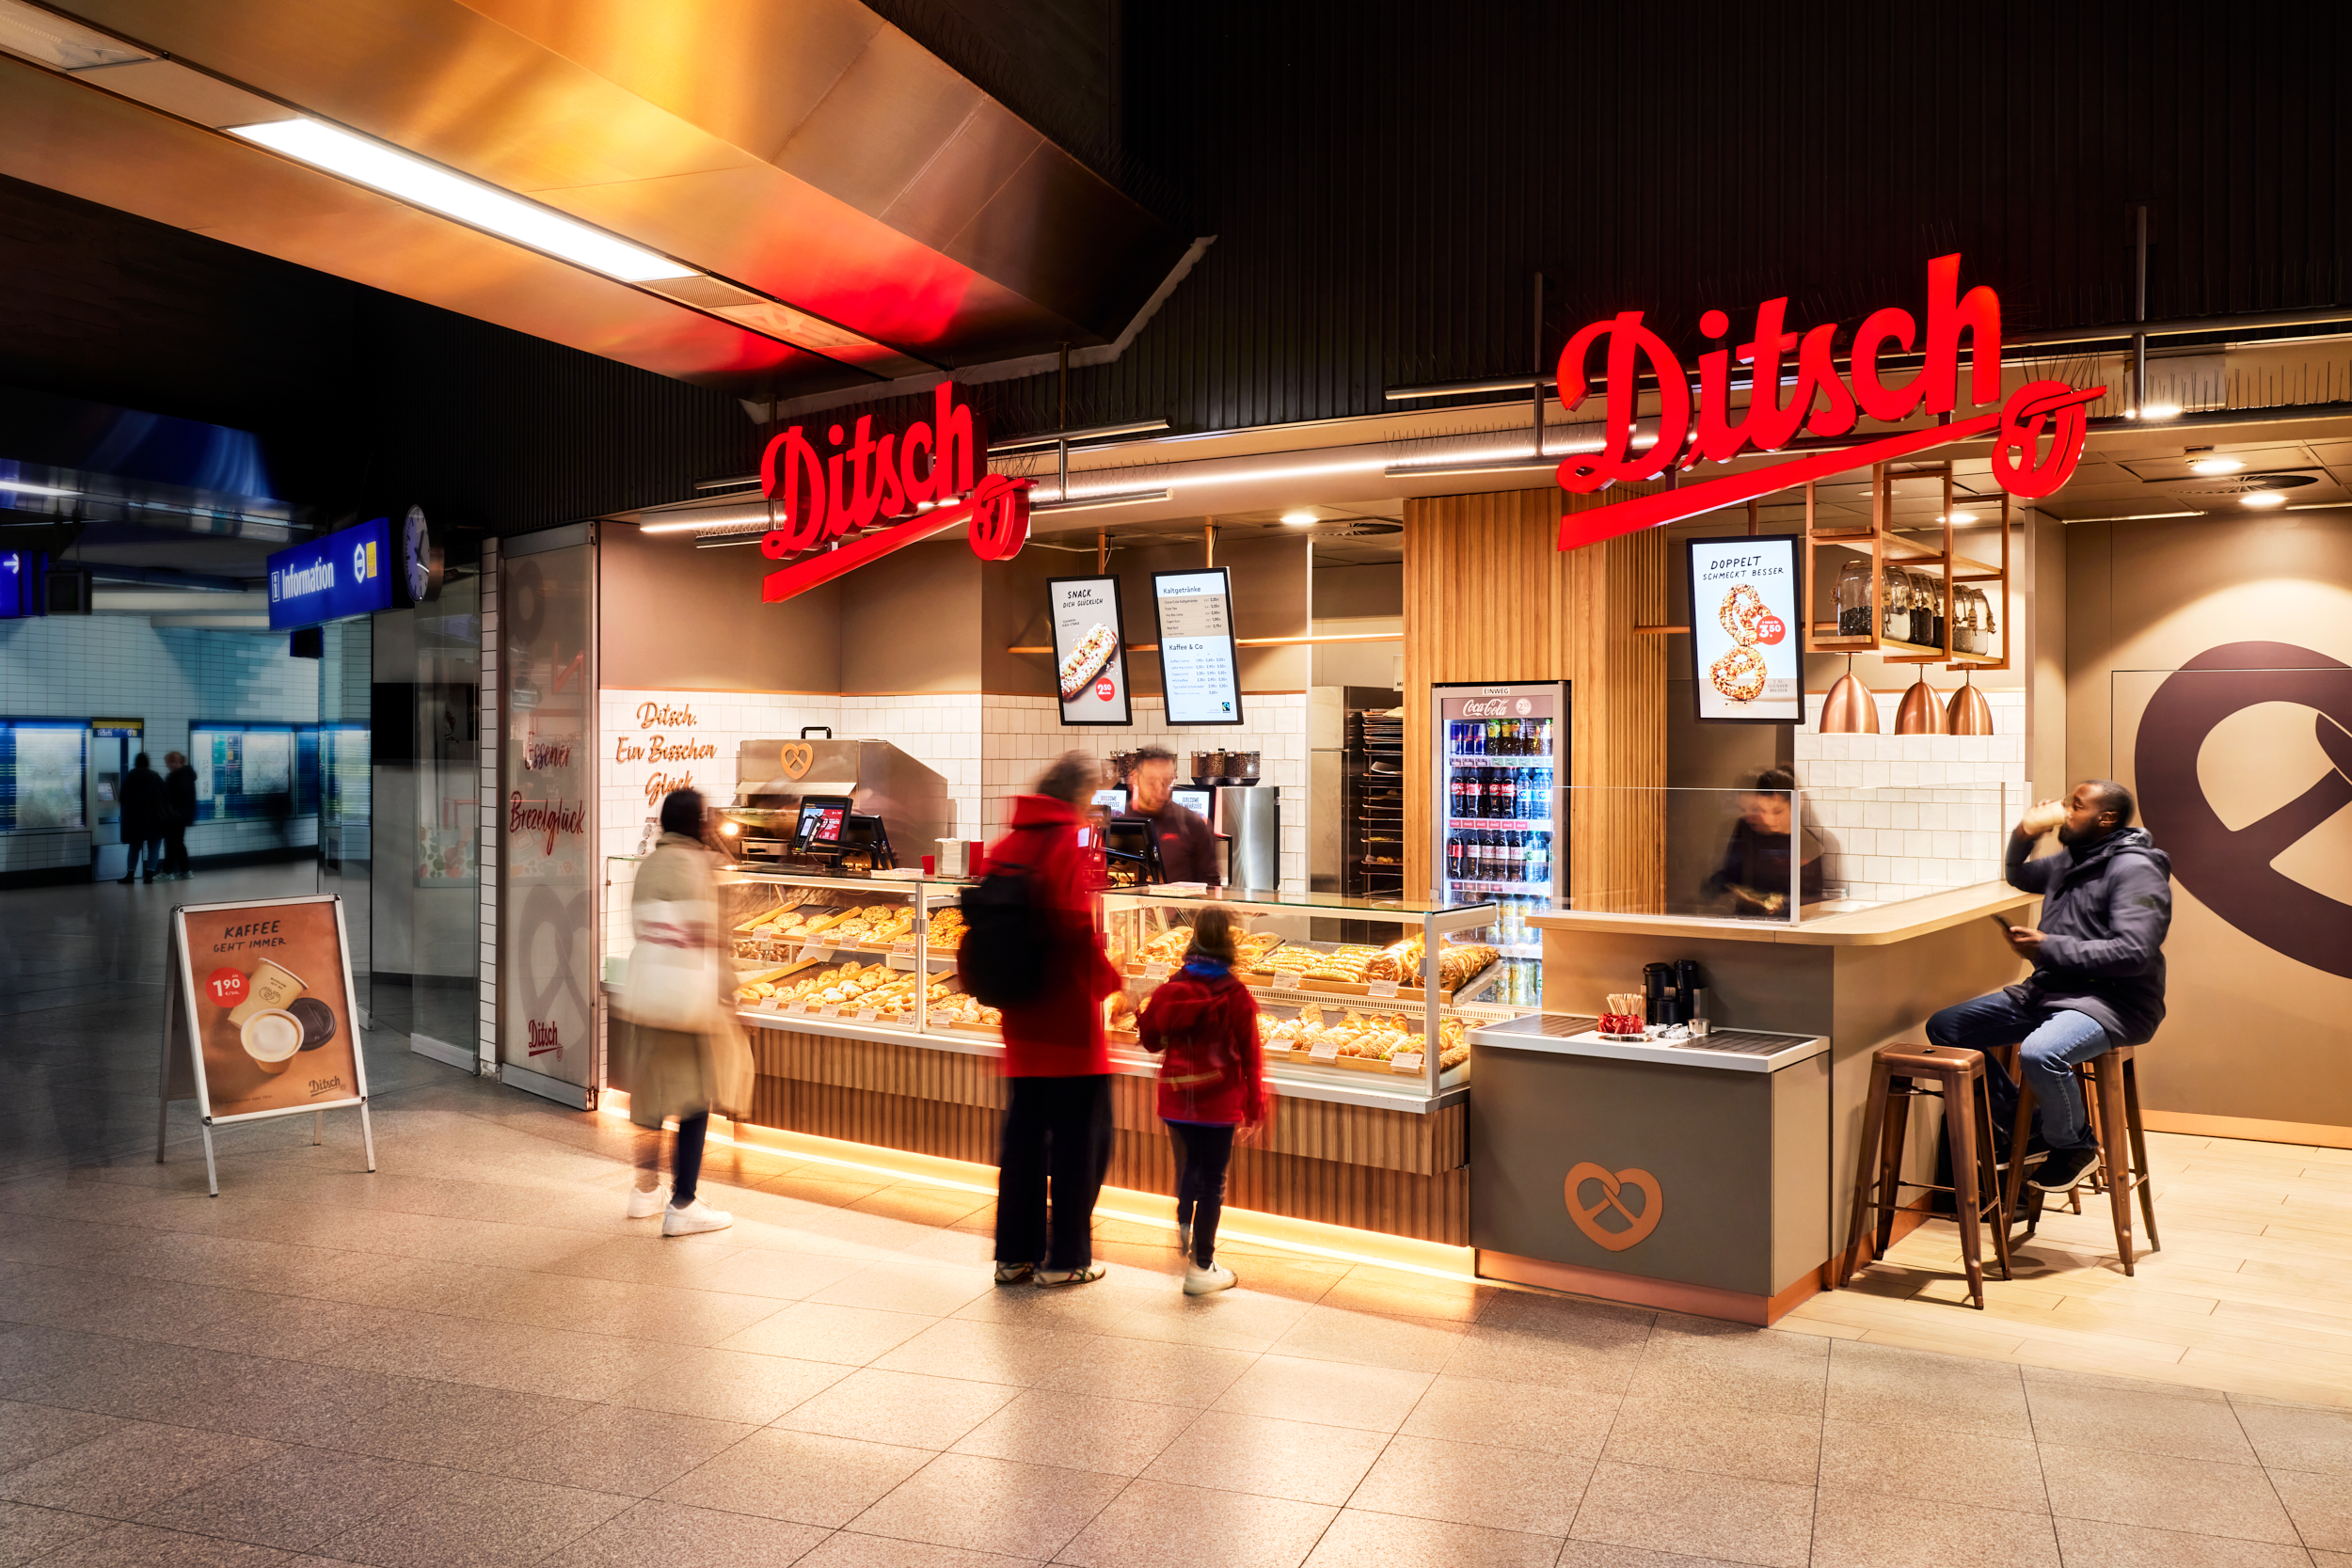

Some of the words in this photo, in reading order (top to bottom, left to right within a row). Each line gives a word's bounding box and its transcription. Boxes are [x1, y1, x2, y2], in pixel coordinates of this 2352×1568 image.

[1557, 253, 2001, 494] Ditsch
[761, 380, 975, 560] Ditsch
[1710, 555, 1762, 570] DOPPELT
[282, 556, 334, 600] Information
[1703, 570, 1747, 580] SCHMECKT
[1752, 567, 1784, 577] BESSER
[1067, 589, 1091, 599] SNACK
[1163, 586, 1201, 594] Kaltgetränke
[1077, 597, 1104, 607] GLÜCKLICH
[636, 701, 697, 729] Ditsch.
[616, 736, 645, 763] Ein
[647, 735, 718, 763] Bisschen
[509, 790, 585, 856] Brezelglück
[224, 920, 281, 940] KAFFEE
[213, 942, 246, 953] GEHT
[249, 937, 287, 949] IMMER
[528, 1019, 558, 1049] Ditsch
[309, 1075, 341, 1094] Ditsch
